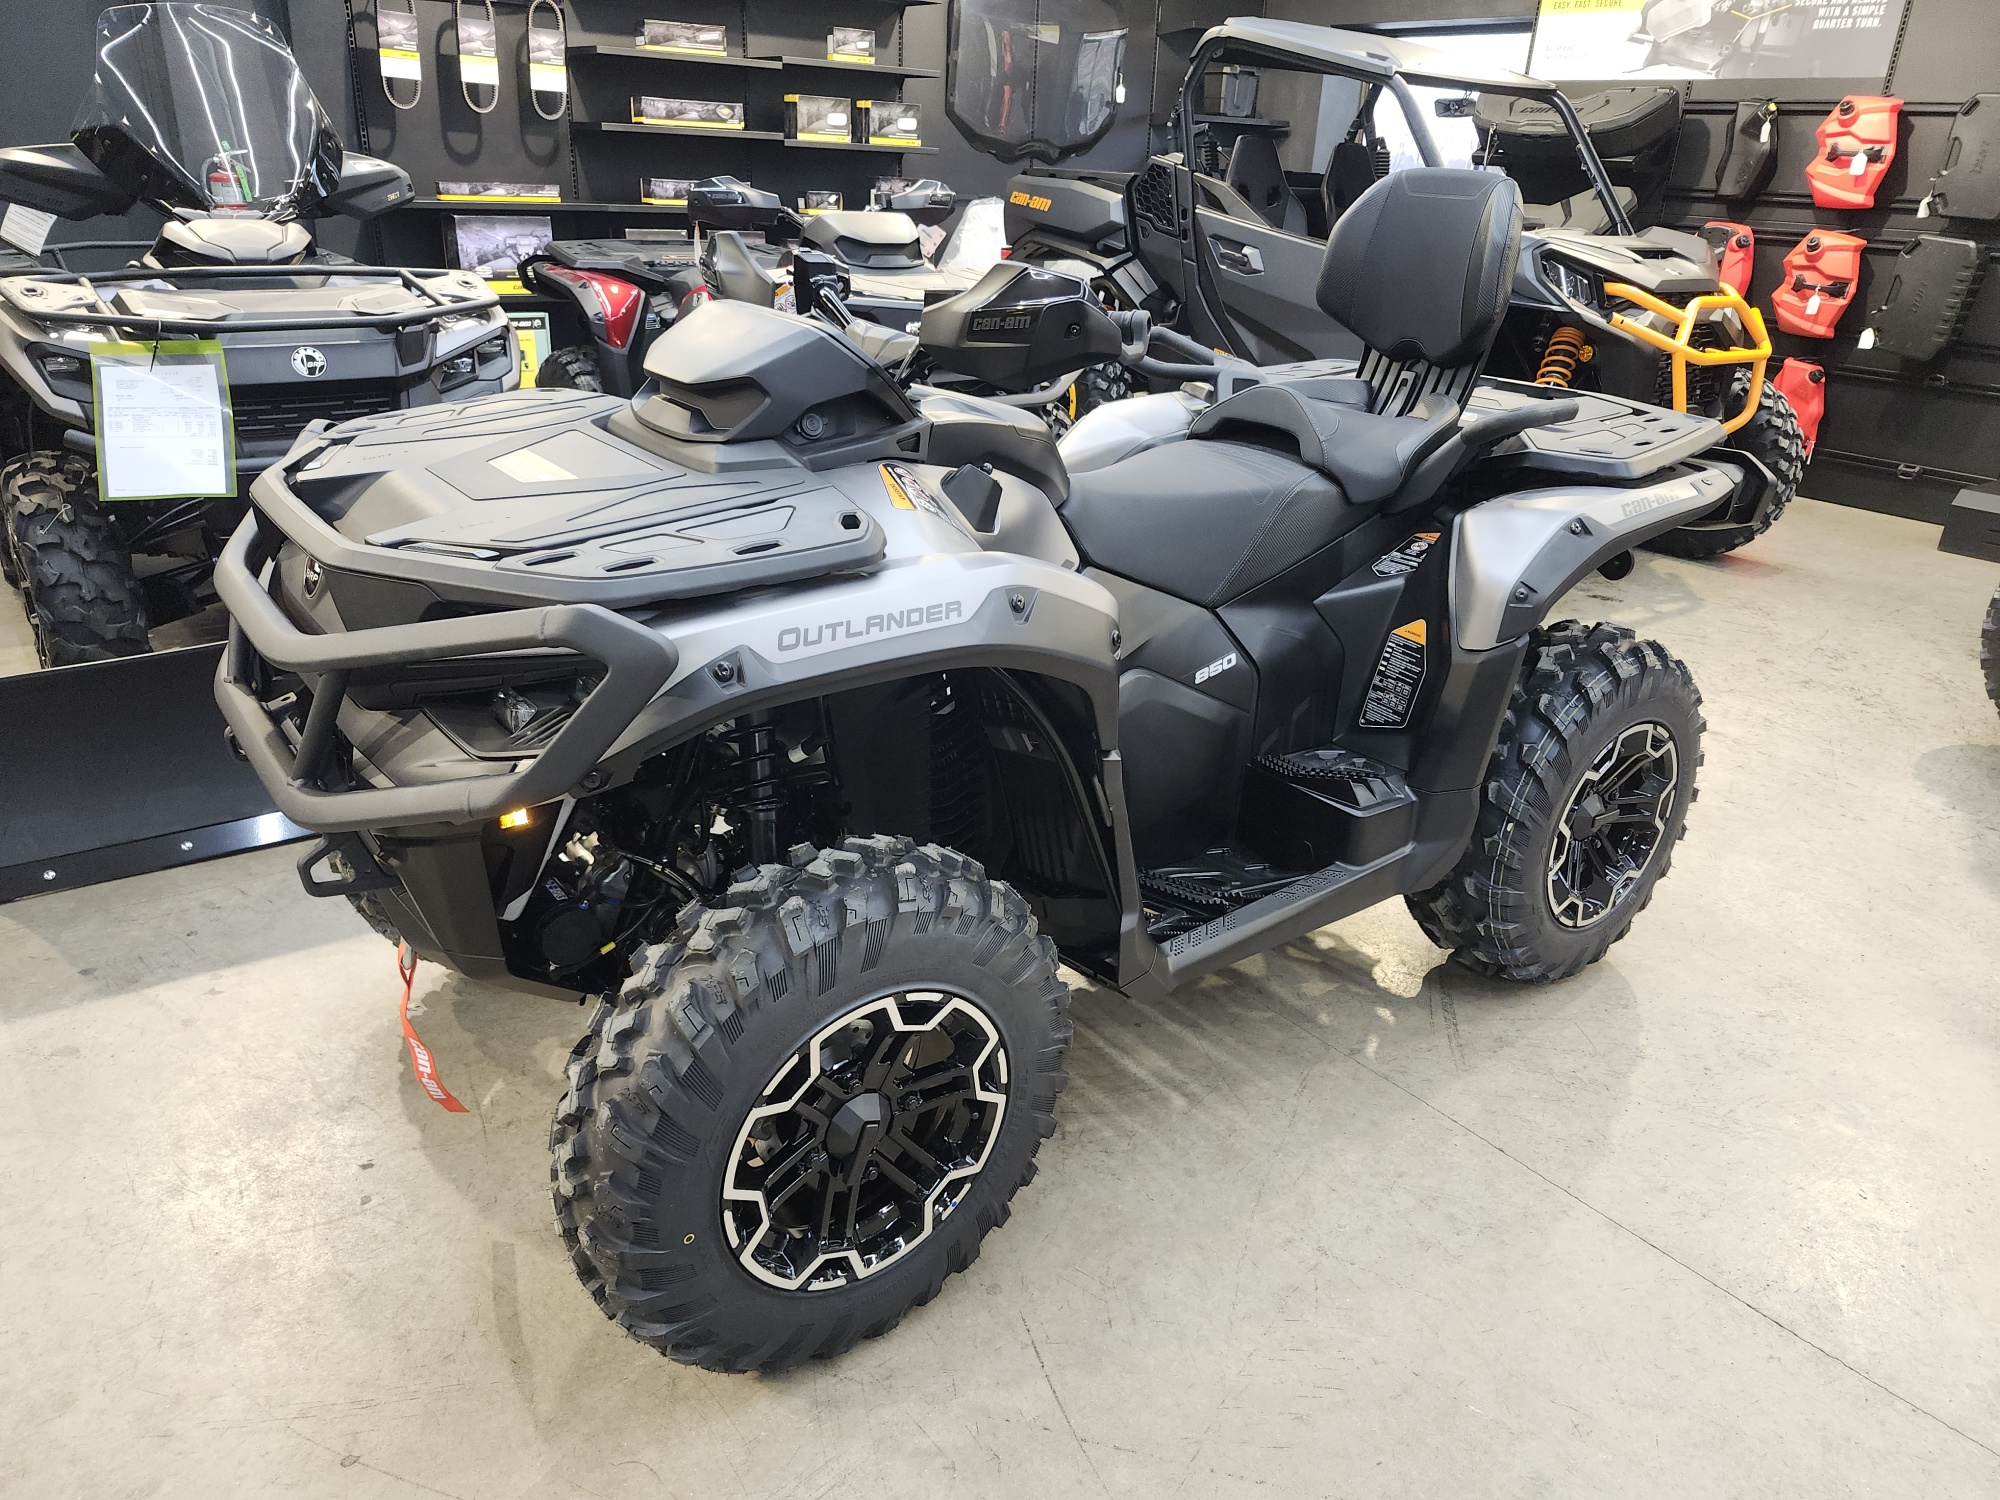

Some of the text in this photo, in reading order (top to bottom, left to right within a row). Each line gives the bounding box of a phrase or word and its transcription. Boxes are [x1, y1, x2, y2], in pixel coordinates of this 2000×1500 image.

[1813, 18, 1853, 29] QUARTER
[1818, 5, 1887, 17] WITH A SIMPLE
[1009, 191, 1052, 212] can-am
[972, 315, 1031, 331] can-am
[1621, 488, 1681, 517] can-am
[777, 600, 962, 652] OUTLANDER
[1194, 652, 1237, 685] 850
[408, 1036, 447, 1099] can-am
